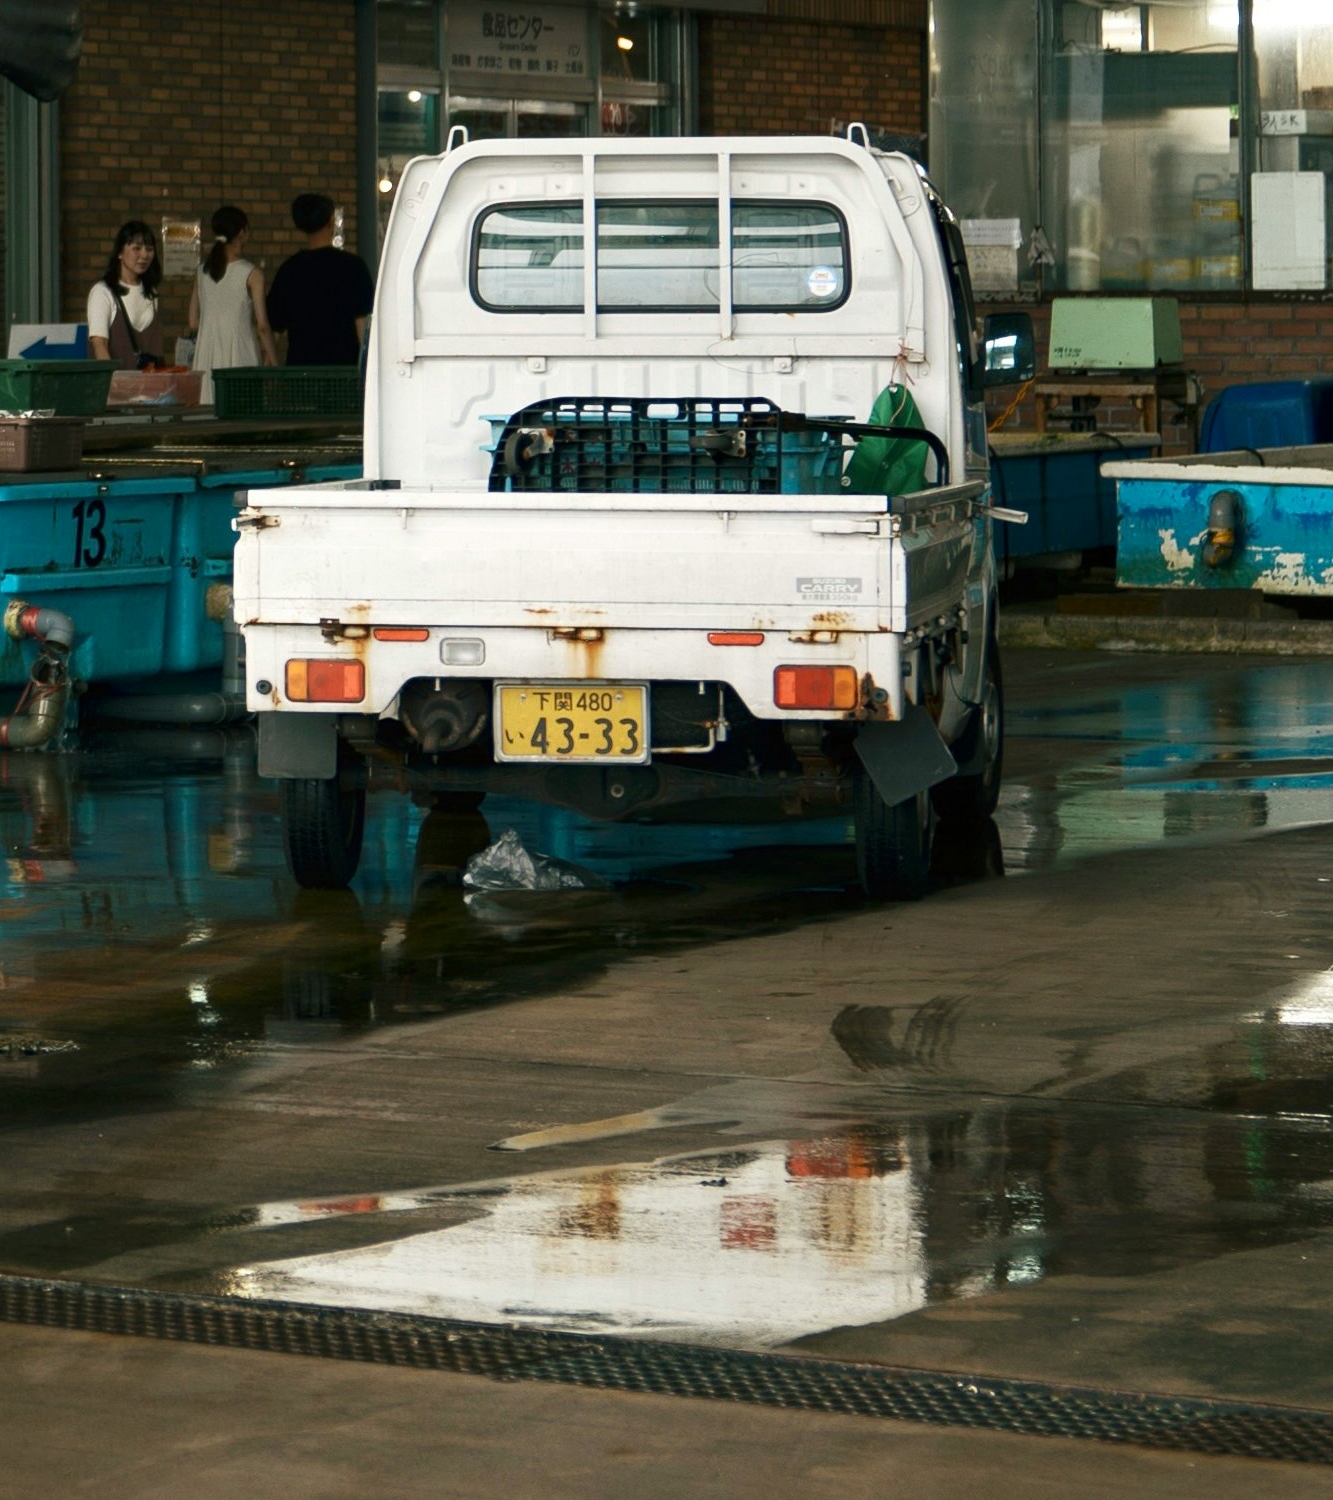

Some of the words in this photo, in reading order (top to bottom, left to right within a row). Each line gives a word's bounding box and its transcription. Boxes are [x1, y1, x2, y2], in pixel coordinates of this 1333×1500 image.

[482, 11, 555, 40] 食品センター
[71, 498, 107, 569] 13
[801, 584, 859, 593] CARRY
[505, 728, 525, 744] い
[530, 716, 639, 755] 43-33
